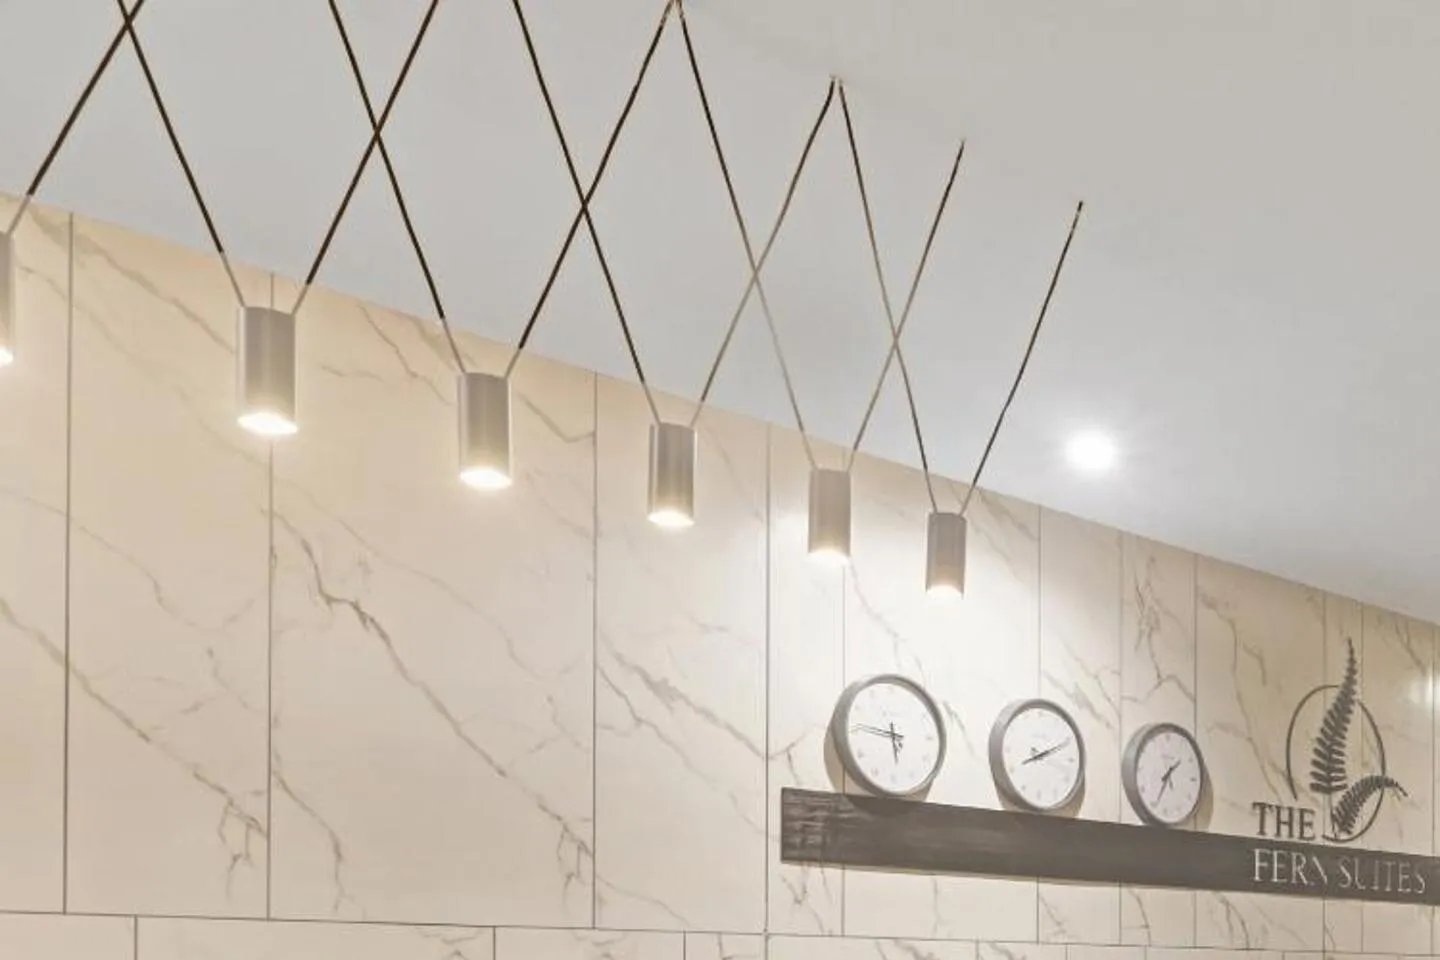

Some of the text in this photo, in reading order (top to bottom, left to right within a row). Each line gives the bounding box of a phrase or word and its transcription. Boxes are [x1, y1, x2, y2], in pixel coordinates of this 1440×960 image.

[1252, 802, 1316, 841] THE
[1253, 848, 1426, 894] FERN SUITES
